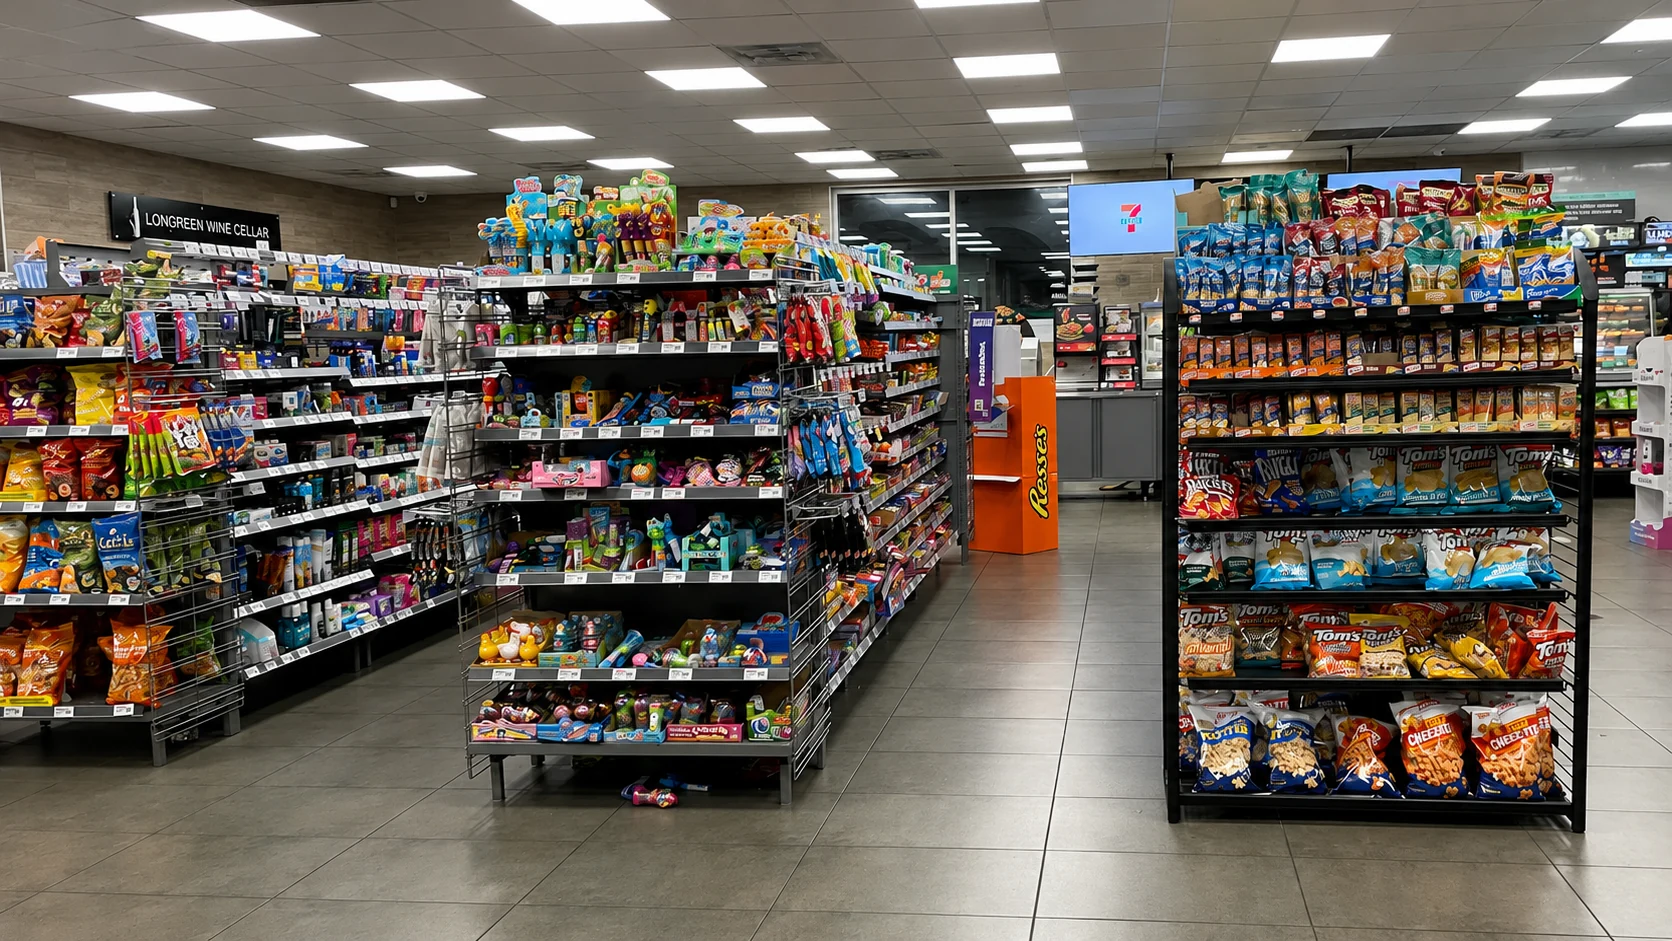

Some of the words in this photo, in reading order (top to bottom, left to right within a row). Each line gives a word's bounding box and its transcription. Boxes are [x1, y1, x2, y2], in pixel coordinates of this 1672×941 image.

[145, 212, 204, 231] LONGREEN
[205, 220, 232, 235] WINE
[233, 223, 269, 239] CELLAR
[1120, 203, 1142, 233] 7
[1402, 447, 1446, 463] Tom's
[1451, 446, 1496, 463] Tom's
[1181, 608, 1228, 626] Tom's
[1314, 629, 1361, 642] Tom's
